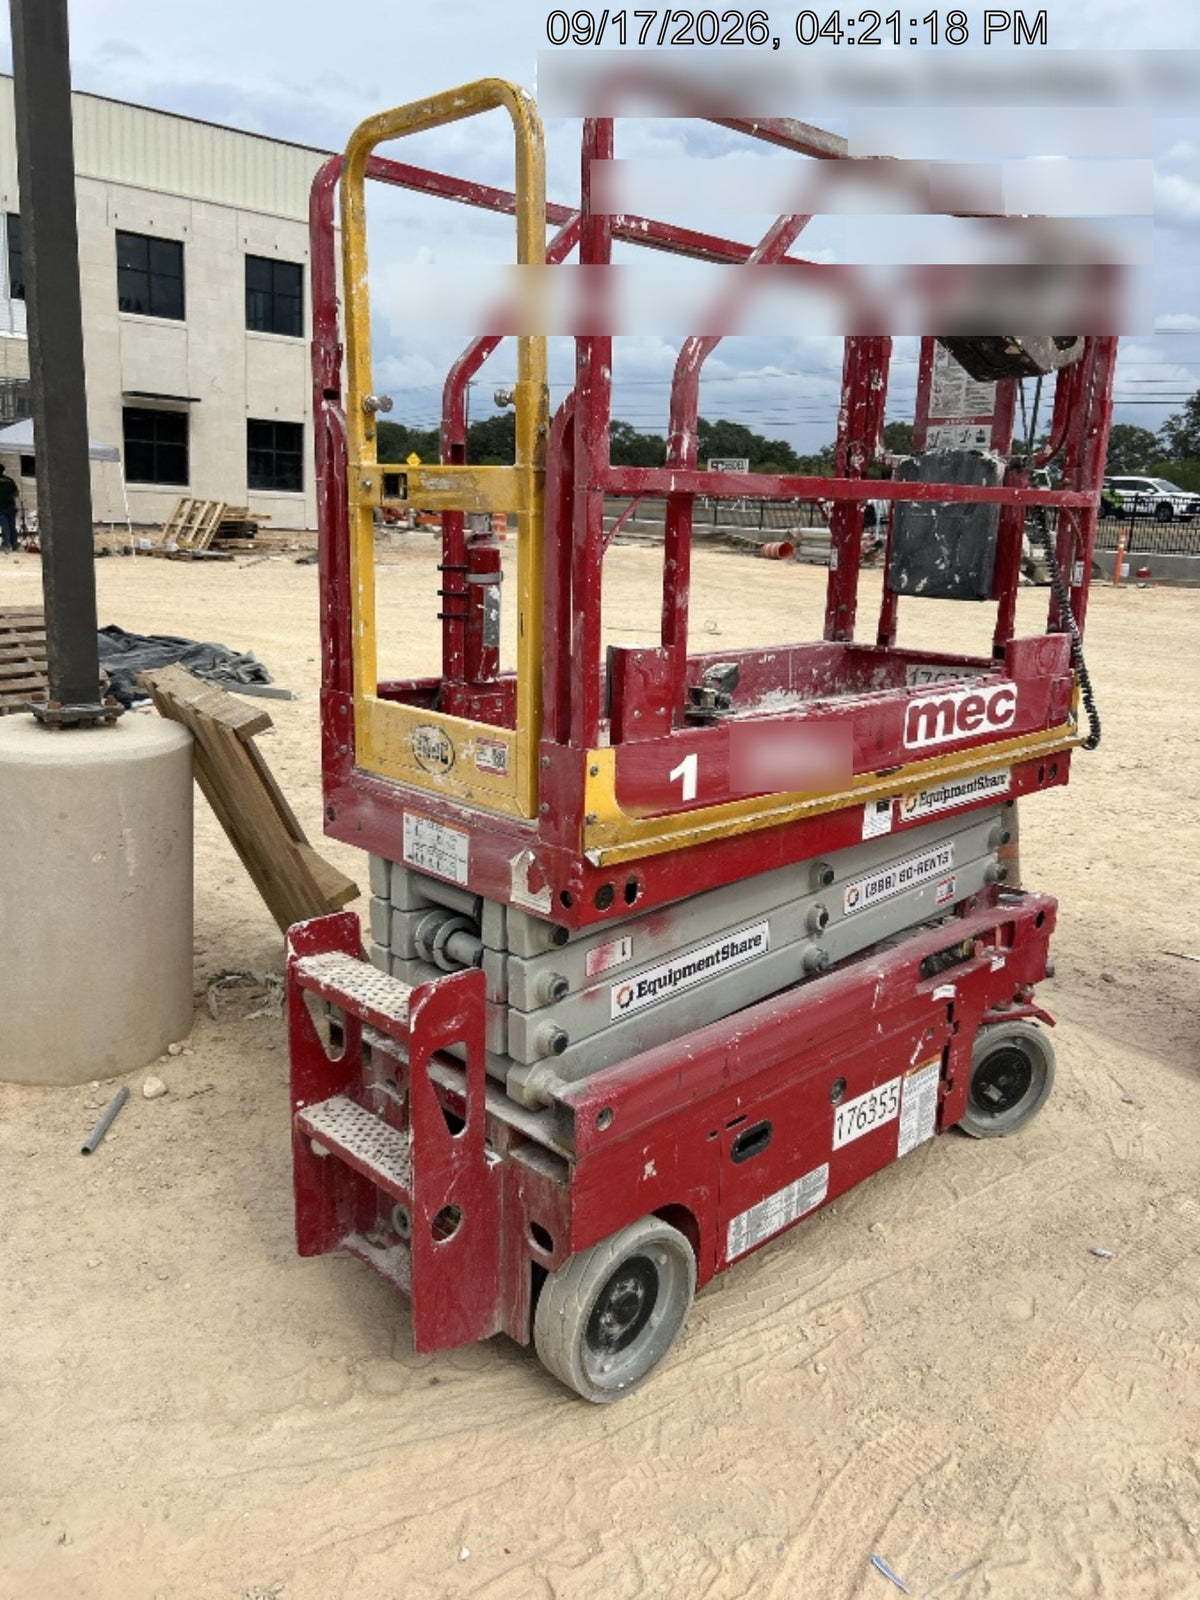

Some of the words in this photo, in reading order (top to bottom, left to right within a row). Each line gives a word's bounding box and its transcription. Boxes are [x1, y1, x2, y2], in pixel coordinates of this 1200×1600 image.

[906, 689, 1015, 744] mec
[669, 753, 698, 802] 1
[636, 933, 762, 998] EquipmentShare
[837, 1084, 898, 1140] 176355
